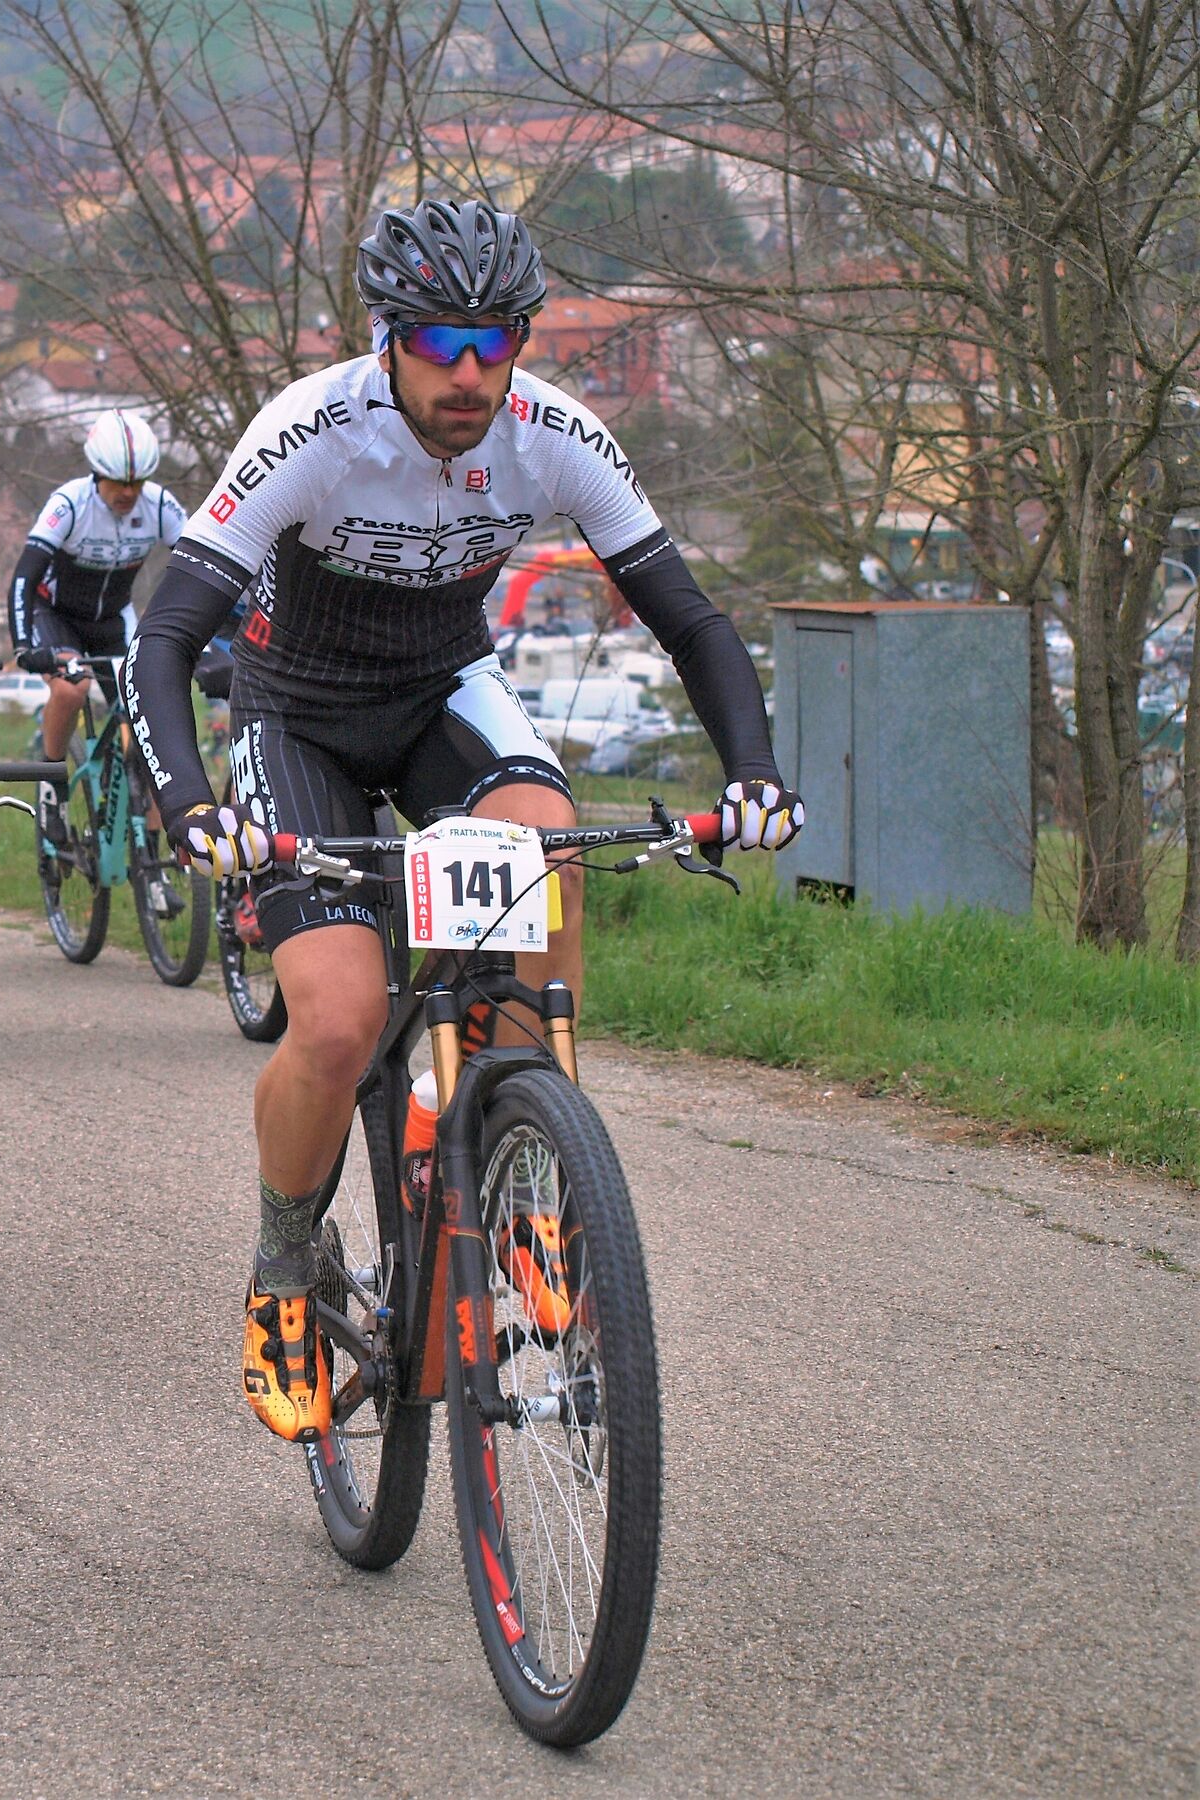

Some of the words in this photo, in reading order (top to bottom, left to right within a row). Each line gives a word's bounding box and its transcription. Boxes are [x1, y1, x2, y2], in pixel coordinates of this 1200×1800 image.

[208, 400, 351, 525] BIEMME
[342, 516, 453, 535] Factory
[133, 715, 173, 792] Road
[252, 720, 271, 796] Factory
[266, 797, 279, 837] Tea
[449, 828, 479, 838] FRATTA
[480, 829, 503, 839] TERME
[414, 853, 429, 940] ABBONATO
[442, 860, 513, 908] 141
[324, 906, 345, 921] LA
[496, 1602, 508, 1615] DT
